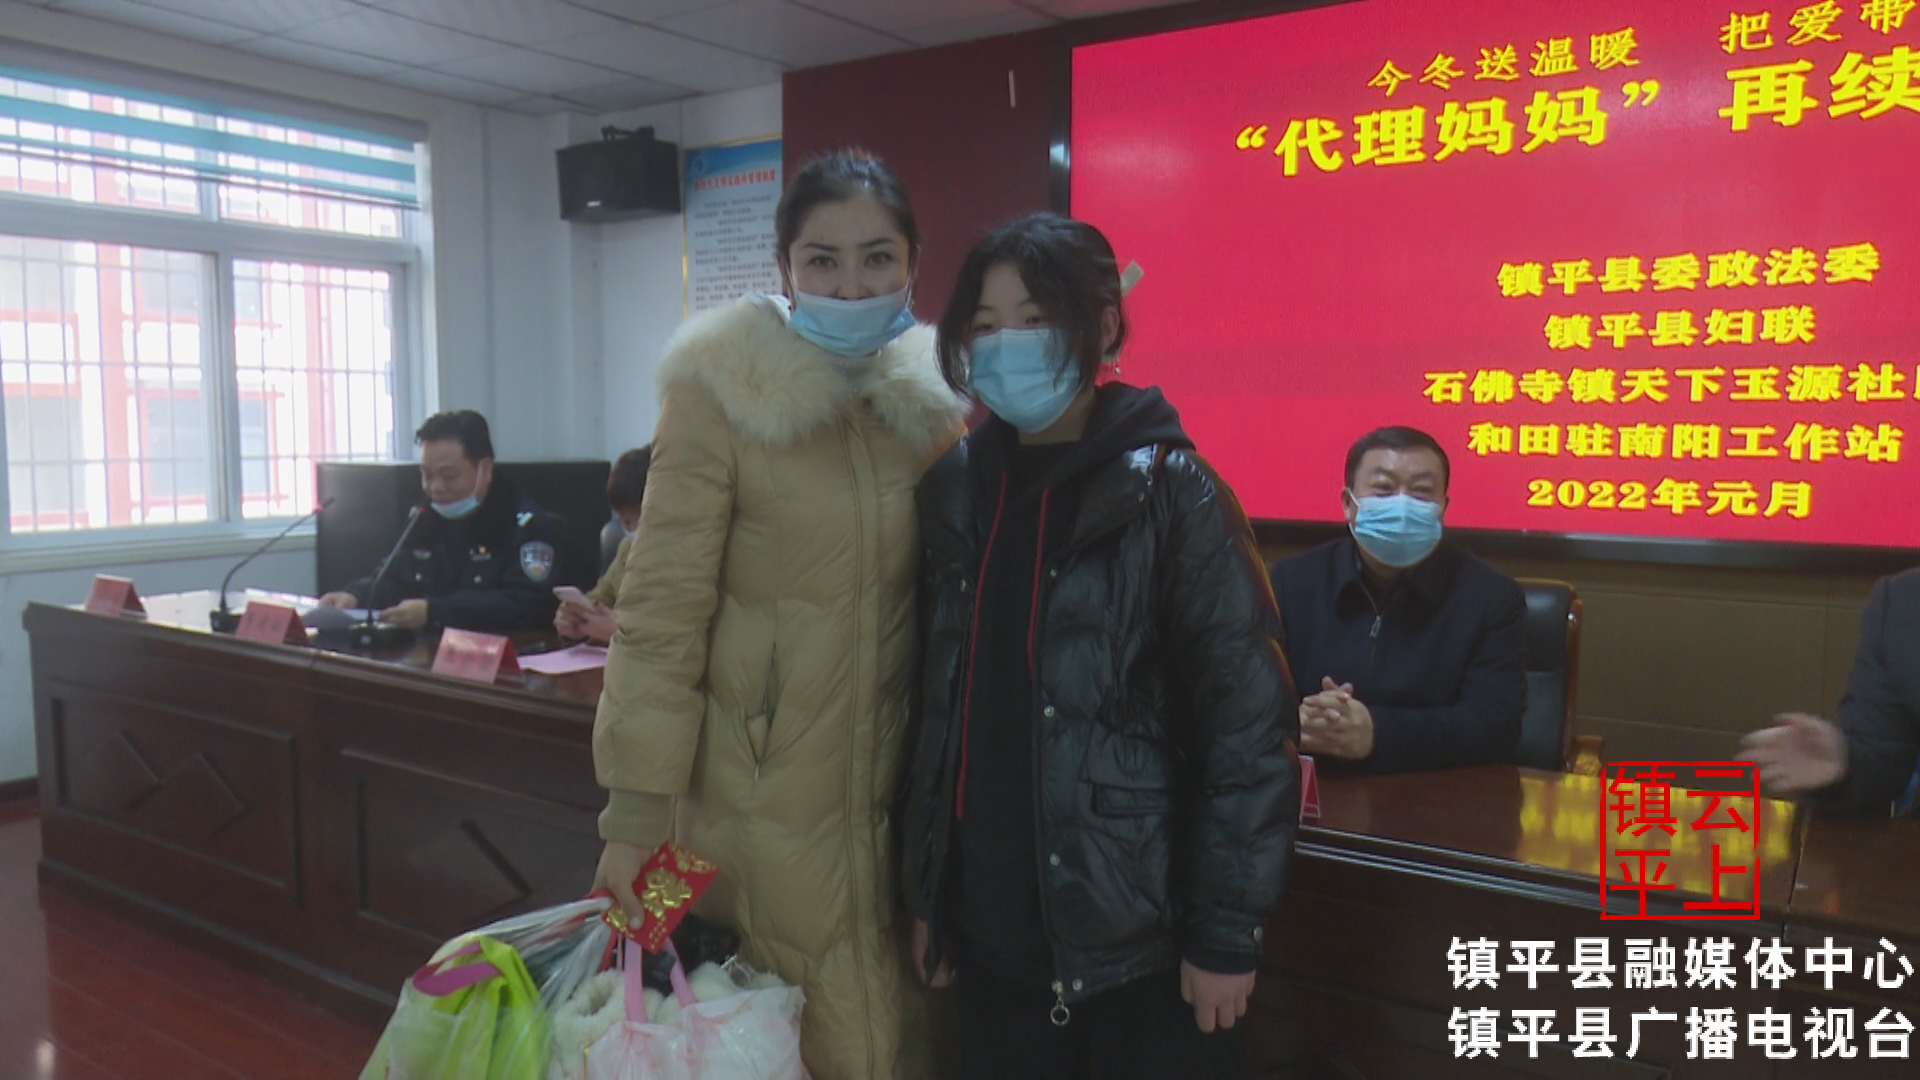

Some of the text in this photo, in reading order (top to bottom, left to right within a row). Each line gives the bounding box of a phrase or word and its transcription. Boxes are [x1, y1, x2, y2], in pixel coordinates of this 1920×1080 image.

[1368, 26, 1640, 97] 今冬送温暖
[1717, 44, 1920, 132] 再续
[1496, 242, 1880, 297] 镇平县委政法委
[1544, 305, 1815, 350] 镇平县妇联
[1423, 363, 1920, 404] 石佛寺镇天下玉源社
[1468, 422, 1903, 462] 和田驻南阳工作站
[1527, 478, 1812, 518] 2022年元月
